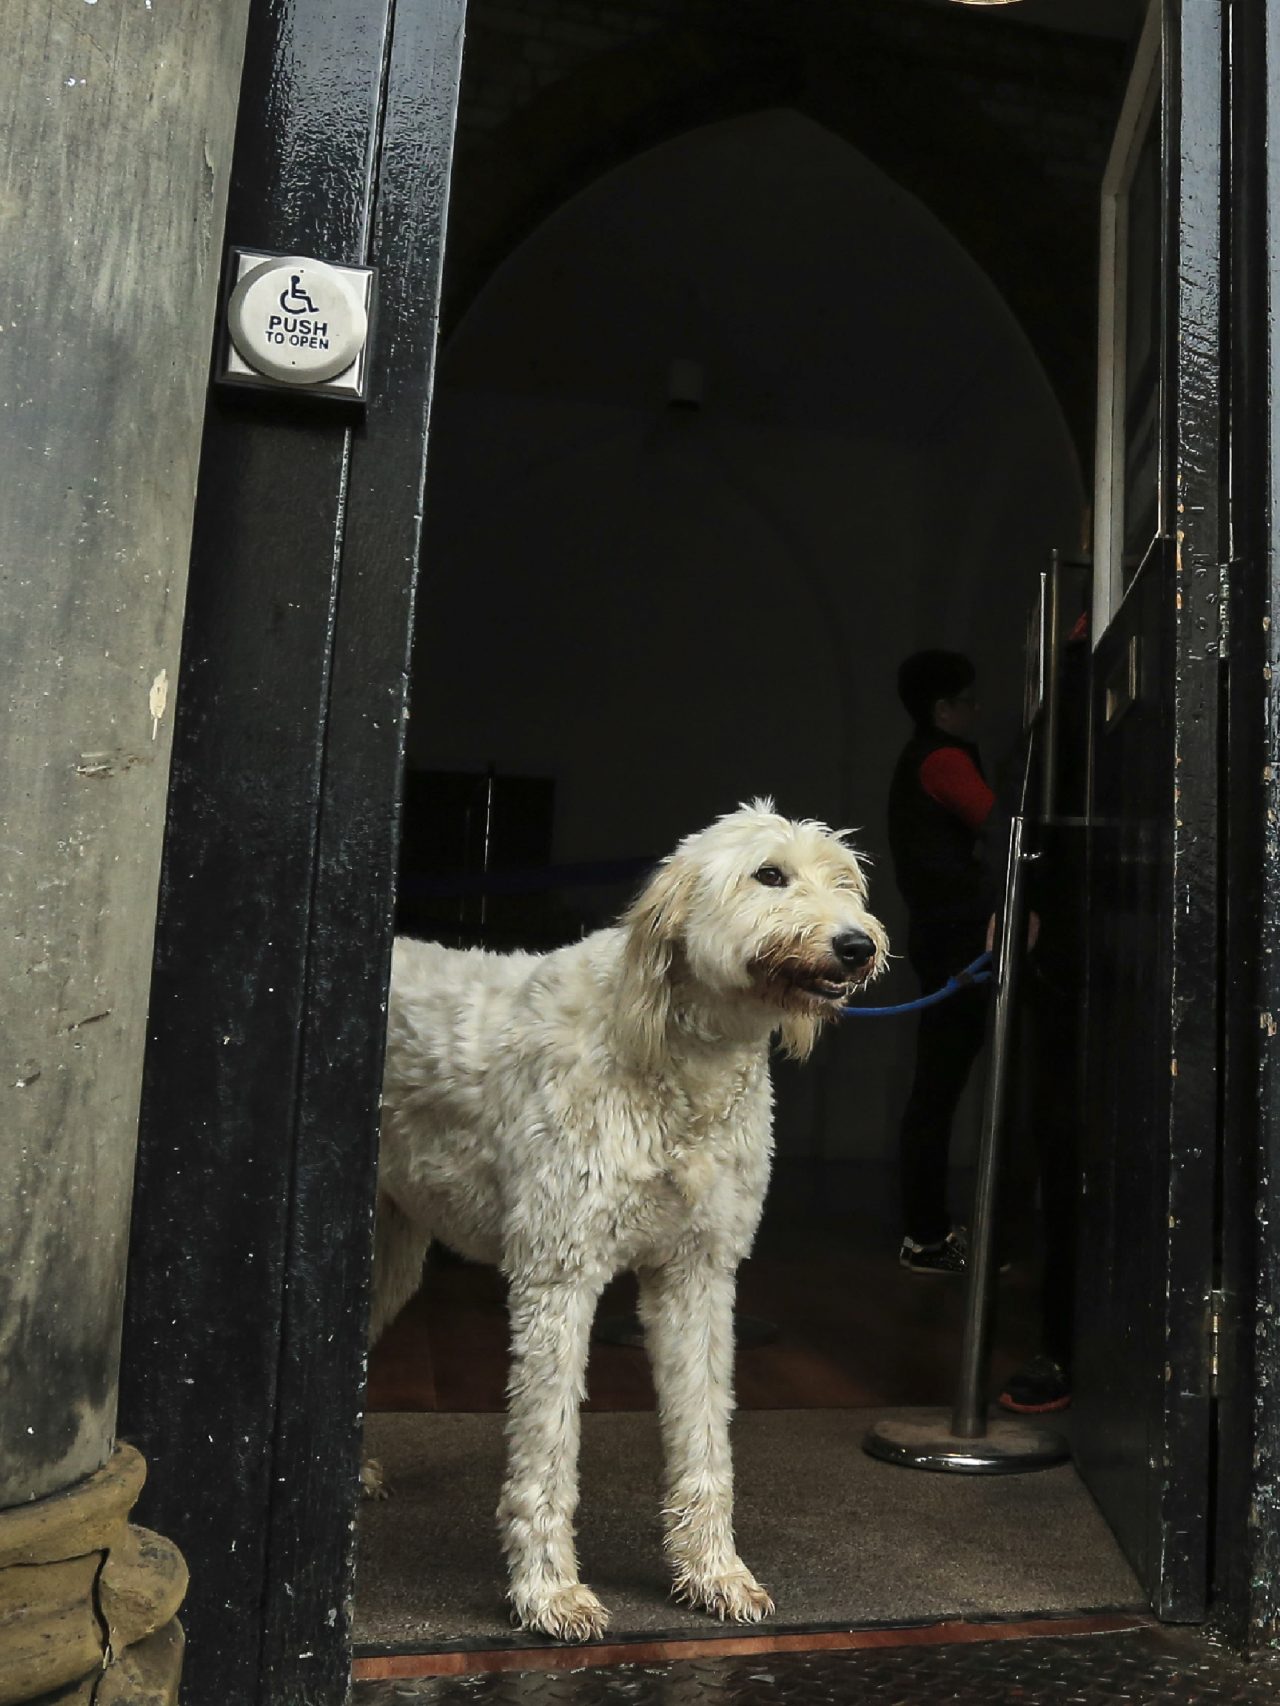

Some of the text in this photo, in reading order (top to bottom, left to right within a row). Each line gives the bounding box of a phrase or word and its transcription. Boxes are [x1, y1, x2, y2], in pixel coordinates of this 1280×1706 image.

[268, 315, 328, 337] PUSH
[265, 331, 329, 349] TO OPEN
